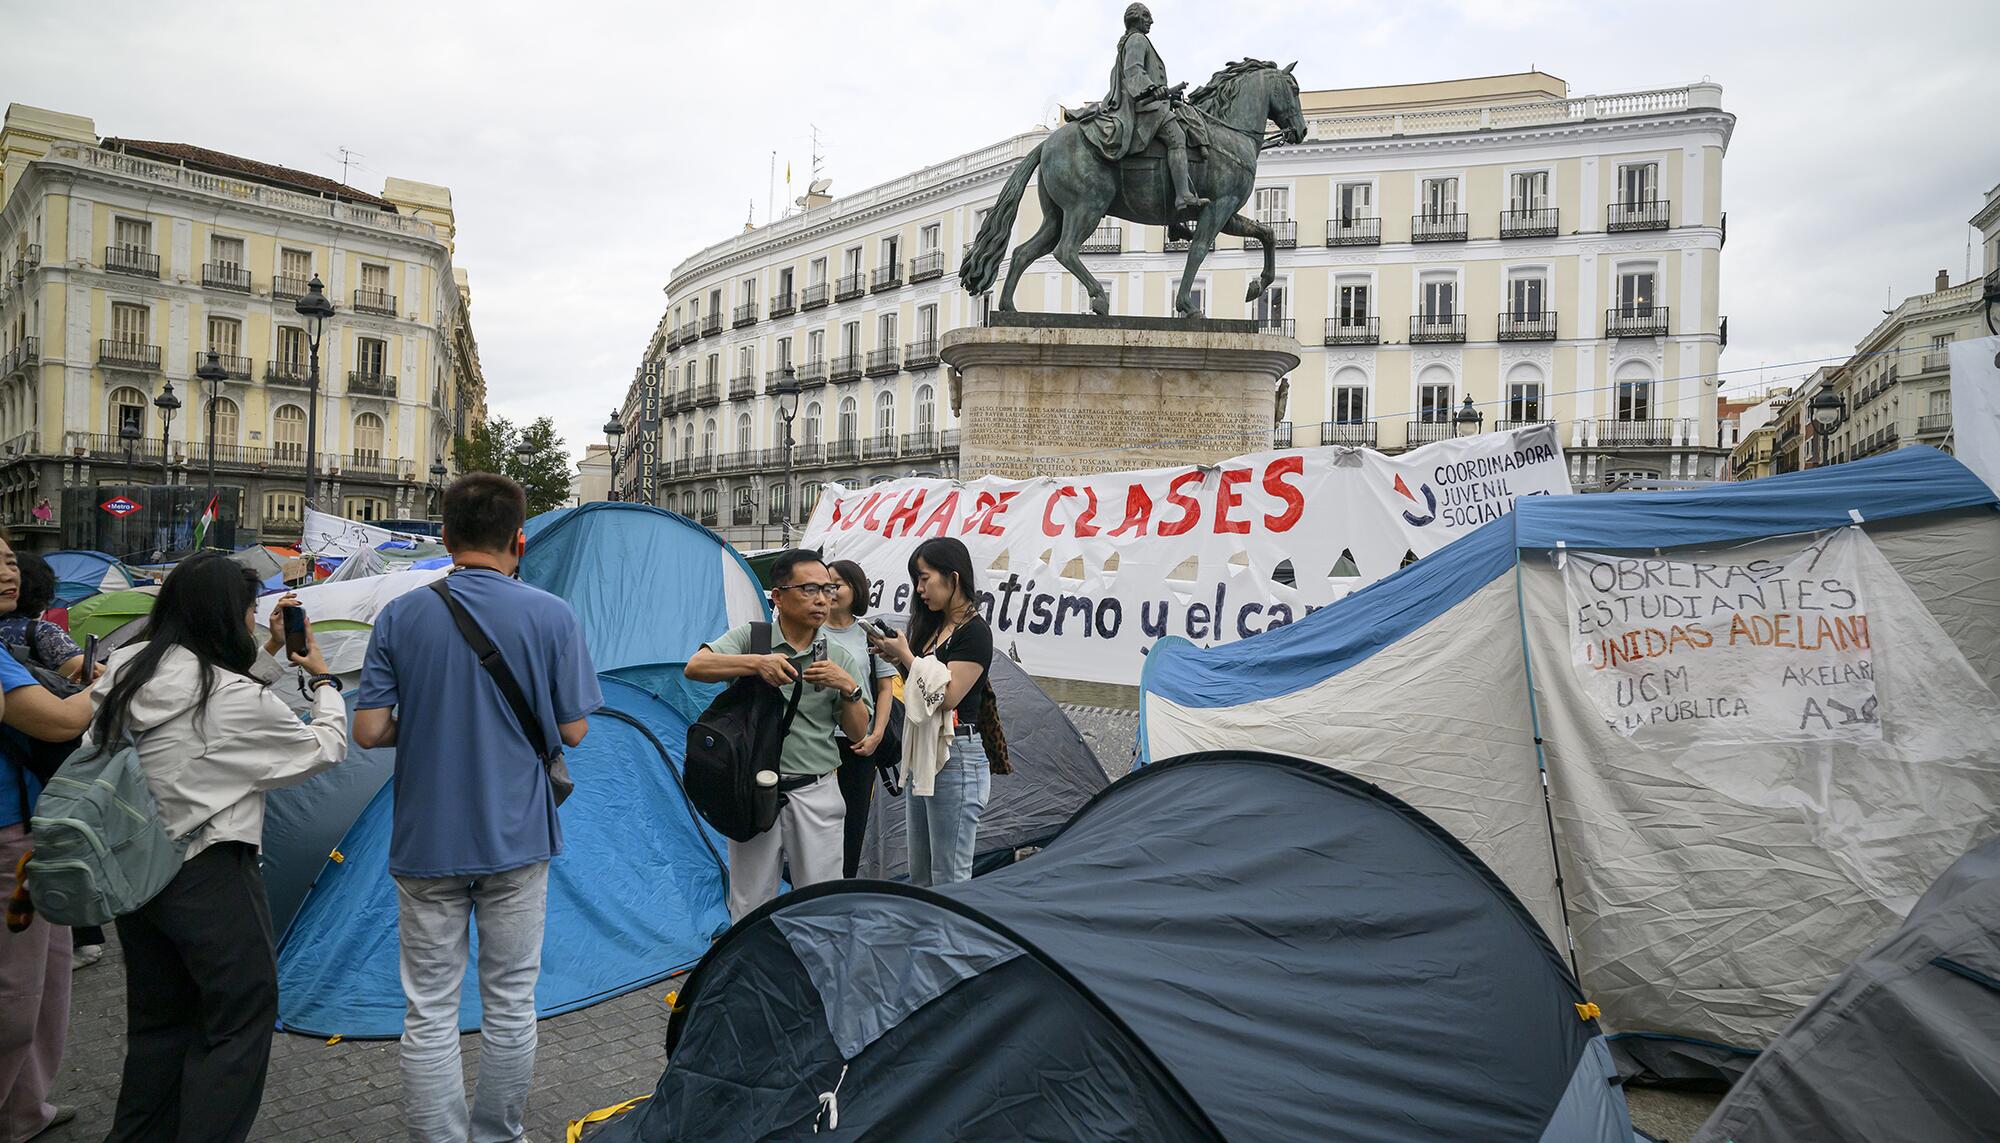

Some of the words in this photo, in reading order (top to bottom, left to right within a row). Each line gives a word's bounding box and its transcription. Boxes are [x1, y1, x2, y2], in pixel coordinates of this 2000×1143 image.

[645, 363, 656, 422] HOTEL
[1434, 443, 1555, 486] COORDINADORA
[111, 503, 131, 511] Metro
[960, 491, 1021, 537] DE
[1041, 455, 1305, 539] CLASES
[1441, 478, 1513, 507] JUVENIL
[1442, 490, 1551, 528] SOCIALI
[1589, 559, 1785, 593] OBRERAS
[1801, 535, 1834, 573] Y
[1140, 600, 1169, 656] y
[1186, 582, 1226, 641] el
[1577, 578, 1857, 635] ESTUDIANTES
[1586, 622, 1714, 671] UNIDAS
[1616, 665, 1690, 708] UCM
